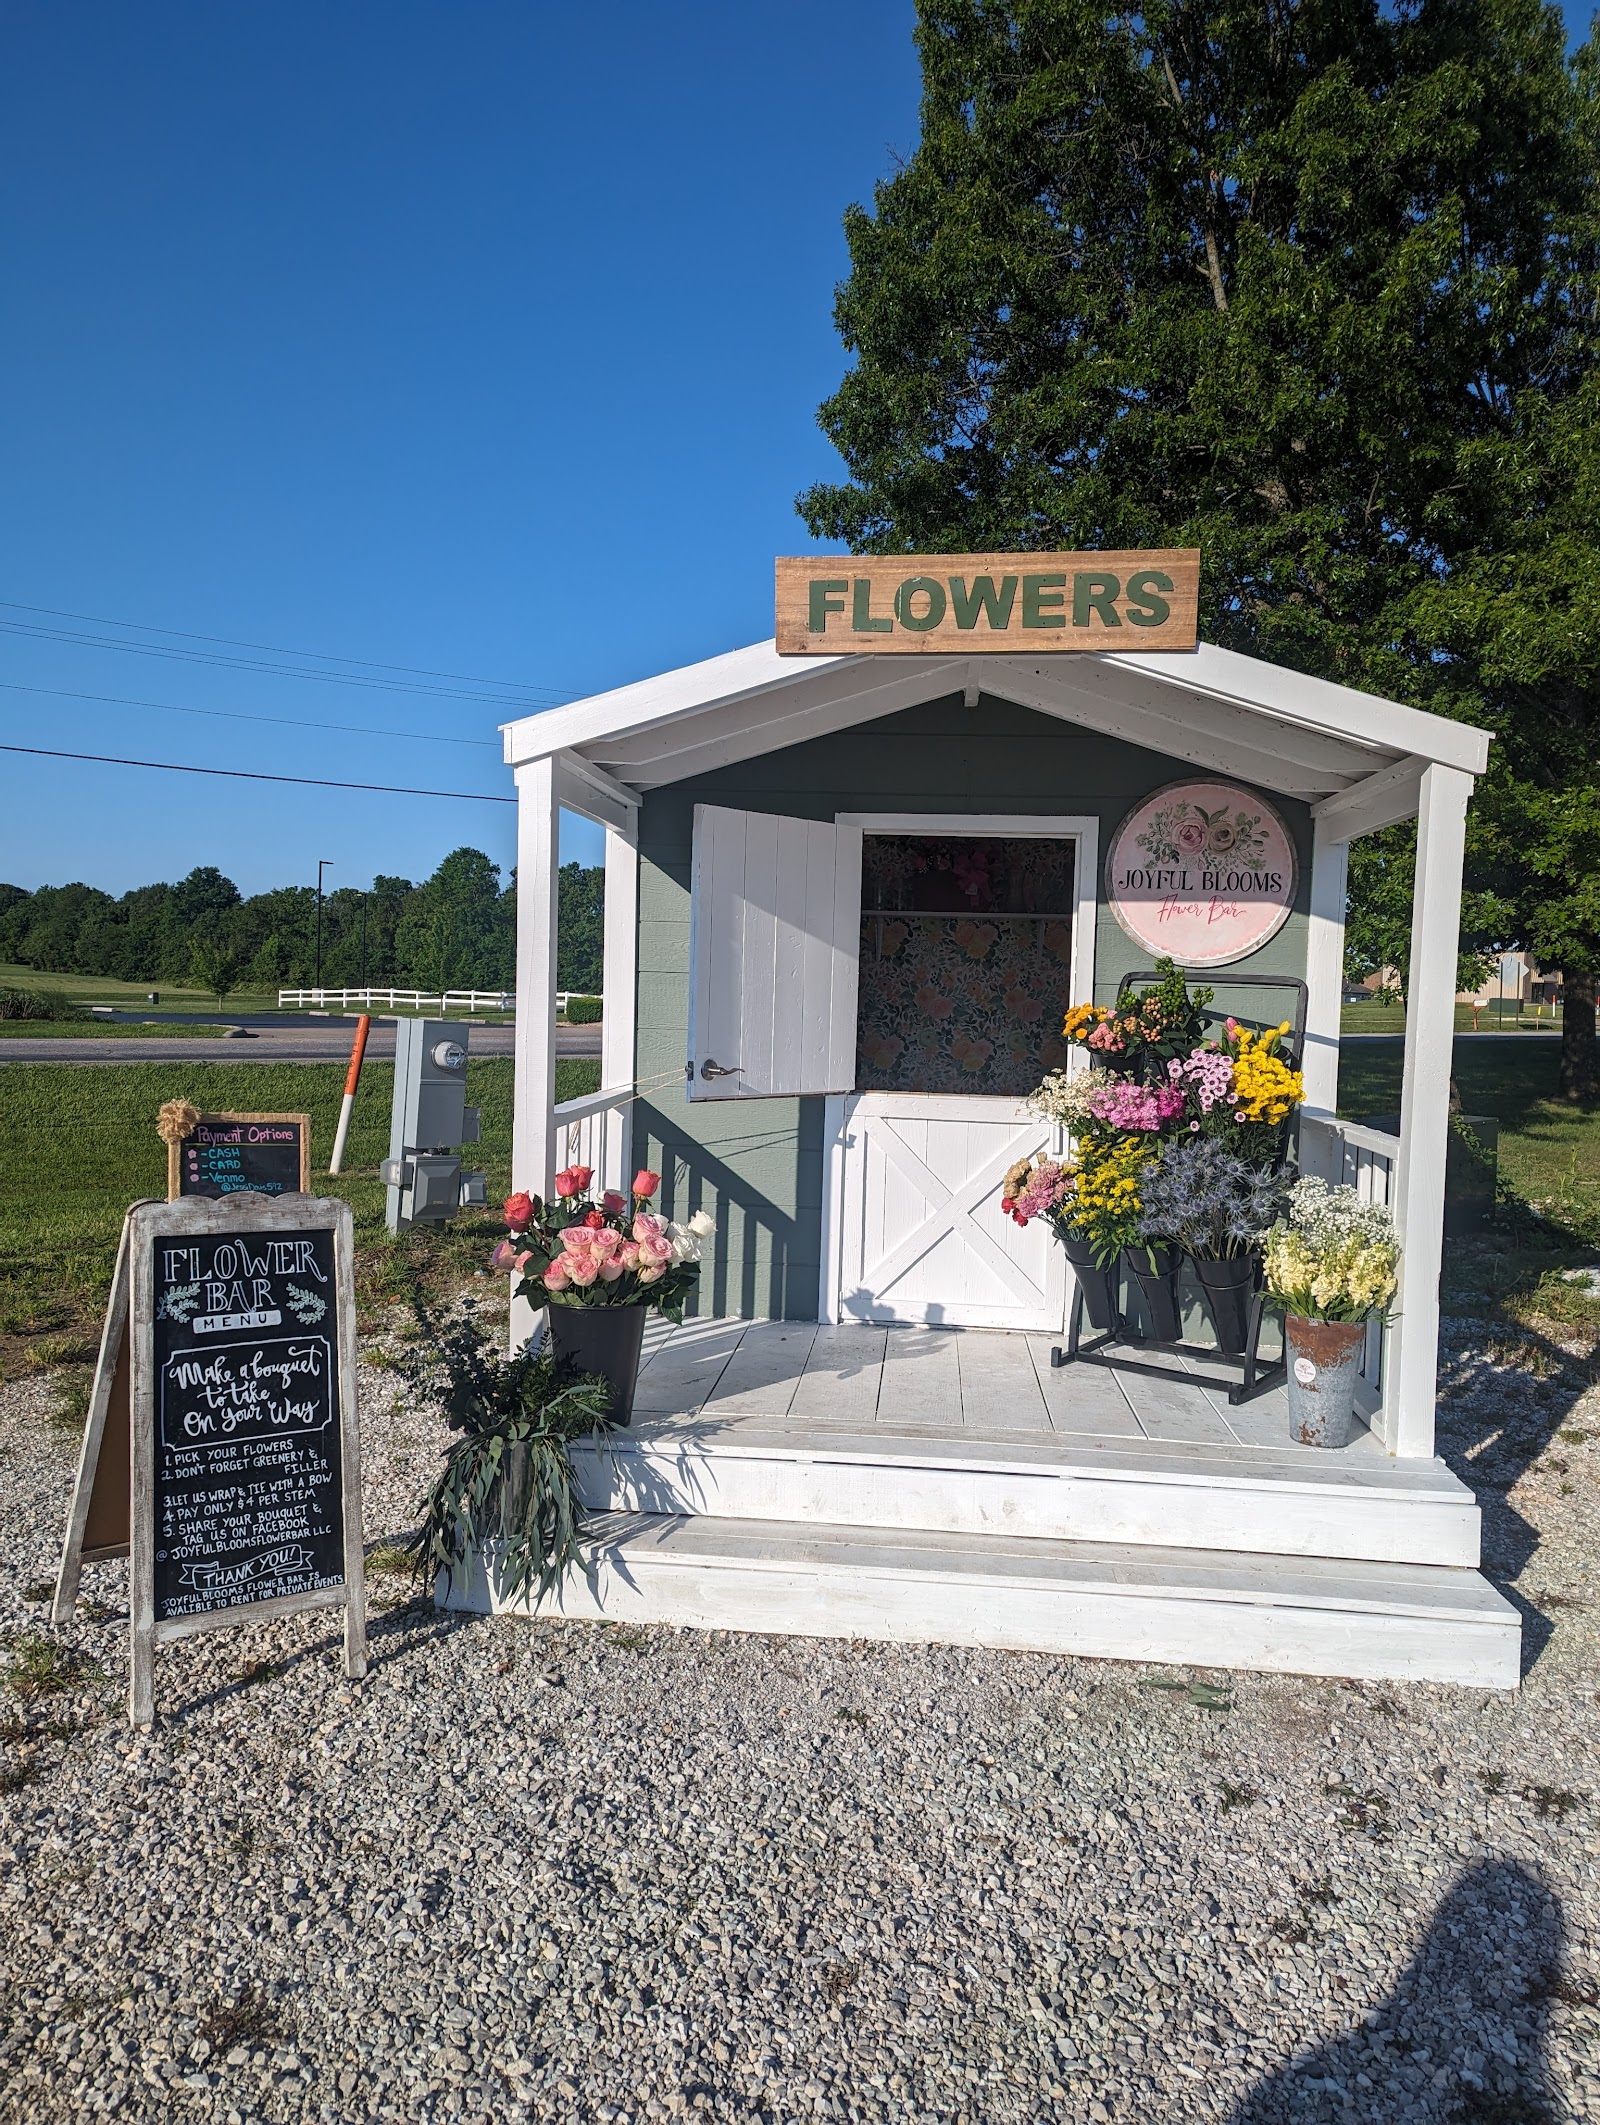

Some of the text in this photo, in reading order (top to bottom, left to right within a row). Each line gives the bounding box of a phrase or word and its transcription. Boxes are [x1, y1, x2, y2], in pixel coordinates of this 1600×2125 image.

[808, 570, 1174, 633] FLOWERS
[1118, 869, 1282, 893] JOYFUL BLOOMS
[1157, 893, 1246, 924] Flower Bar
[196, 1125, 294, 1147] Payment Options
[162, 1239, 327, 1283] FLOWER
[205, 1279, 277, 1313] BAR
[203, 1313, 267, 1329] MENU
[169, 1345, 322, 1389] Make a bouquet
[197, 1381, 270, 1408] to take
[183, 1398, 320, 1436] On your Way
[164, 1439, 294, 1467] 1. PICK YOUR FLOWERS
[210, 1458, 250, 1475] FORGET
[253, 1451, 303, 1467] GREENERY
[309, 1449, 318, 1459] &
[284, 1458, 328, 1475] FILLER
[193, 1491, 206, 1503] US
[247, 1482, 266, 1495] TIE
[269, 1478, 293, 1492] WITH
[298, 1477, 304, 1488] A
[309, 1472, 332, 1486] BOW
[177, 1506, 199, 1520] PAY
[203, 1501, 234, 1516] ONLY
[258, 1492, 280, 1506] PER
[284, 1488, 316, 1501] STEM
[178, 1518, 218, 1535] SHARE
[223, 1514, 252, 1528] YOUR
[257, 1504, 308, 1521] BOUQUET
[312, 1502, 322, 1514] &
[182, 1517, 309, 1545] TAG US ON FACEBOOK
[203, 1547, 296, 1587] THANK YOU!
[247, 1577, 284, 1593] FLOWER
[287, 1574, 309, 1585] BAR
[308, 1571, 320, 1581] IS
[215, 1599, 227, 1608] TO
[231, 1592, 256, 1606] RENT
[258, 1587, 275, 1598] FOR
[277, 1582, 312, 1596] PRIVATE
[314, 1574, 344, 1589] EVENTS
